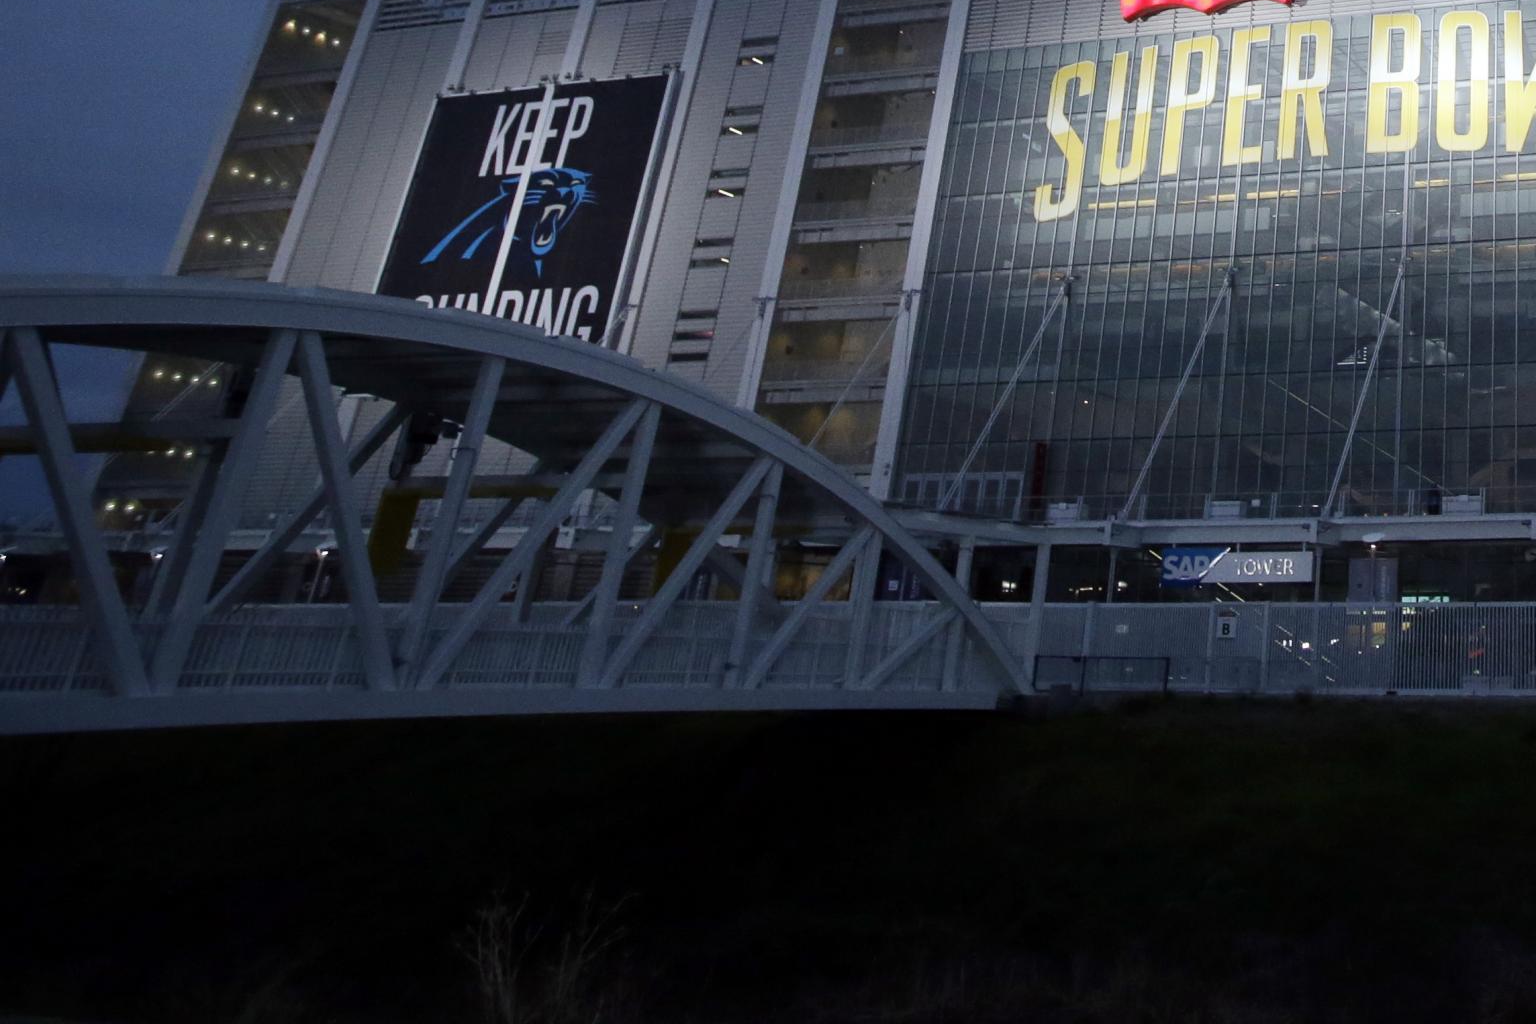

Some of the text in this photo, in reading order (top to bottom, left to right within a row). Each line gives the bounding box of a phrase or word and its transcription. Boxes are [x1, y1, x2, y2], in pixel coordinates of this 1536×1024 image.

[479, 96, 594, 177] KEEP
[1034, 20, 1333, 222] SUPER
[1163, 555, 1294, 580] SAP TOWER
[1222, 623, 1231, 636] B
